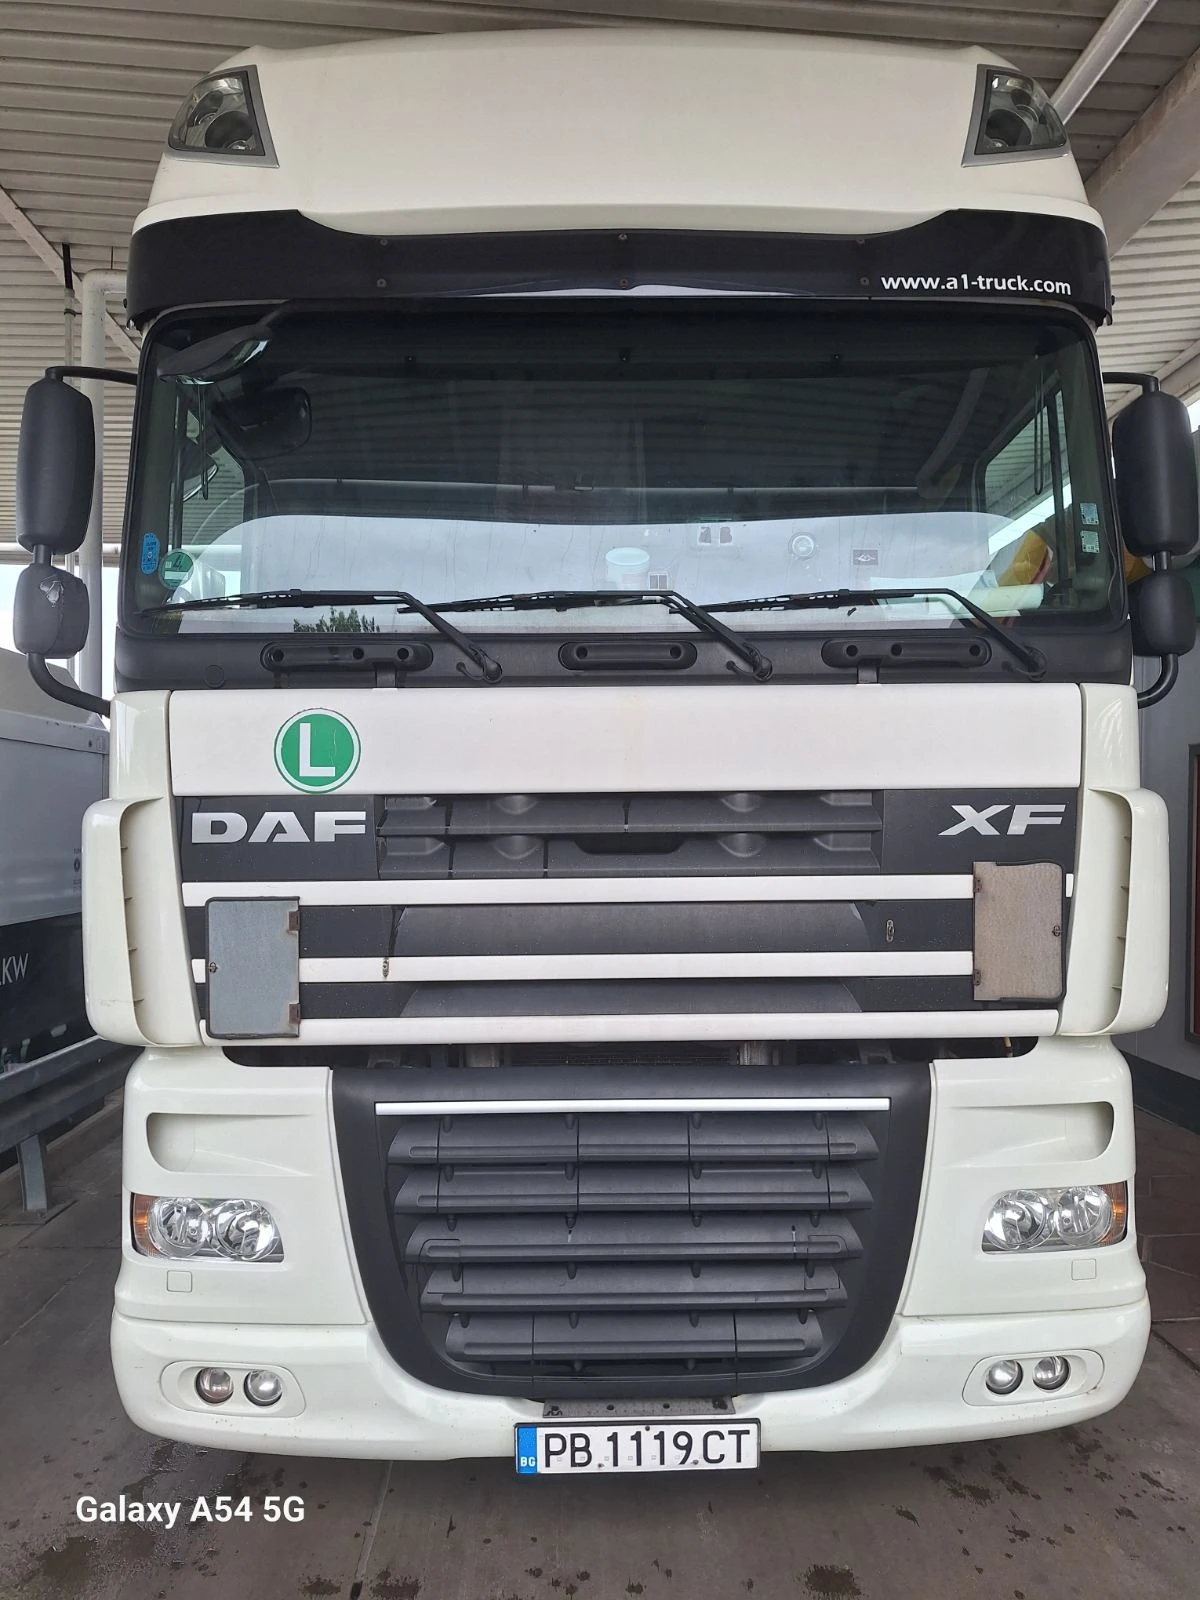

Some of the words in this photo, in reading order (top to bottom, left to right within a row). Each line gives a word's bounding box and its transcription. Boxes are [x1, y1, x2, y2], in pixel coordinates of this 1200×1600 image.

[881, 273, 1072, 296] www.a1-truck.com
[299, 722, 336, 777] L
[191, 811, 367, 844] DAF
[938, 804, 1066, 836] XF
[0, 952, 29, 986] KW
[520, 1457, 536, 1467] BG
[544, 1432, 593, 1468] PB
[606, 1430, 693, 1467] 1119
[702, 1429, 750, 1464] CT
